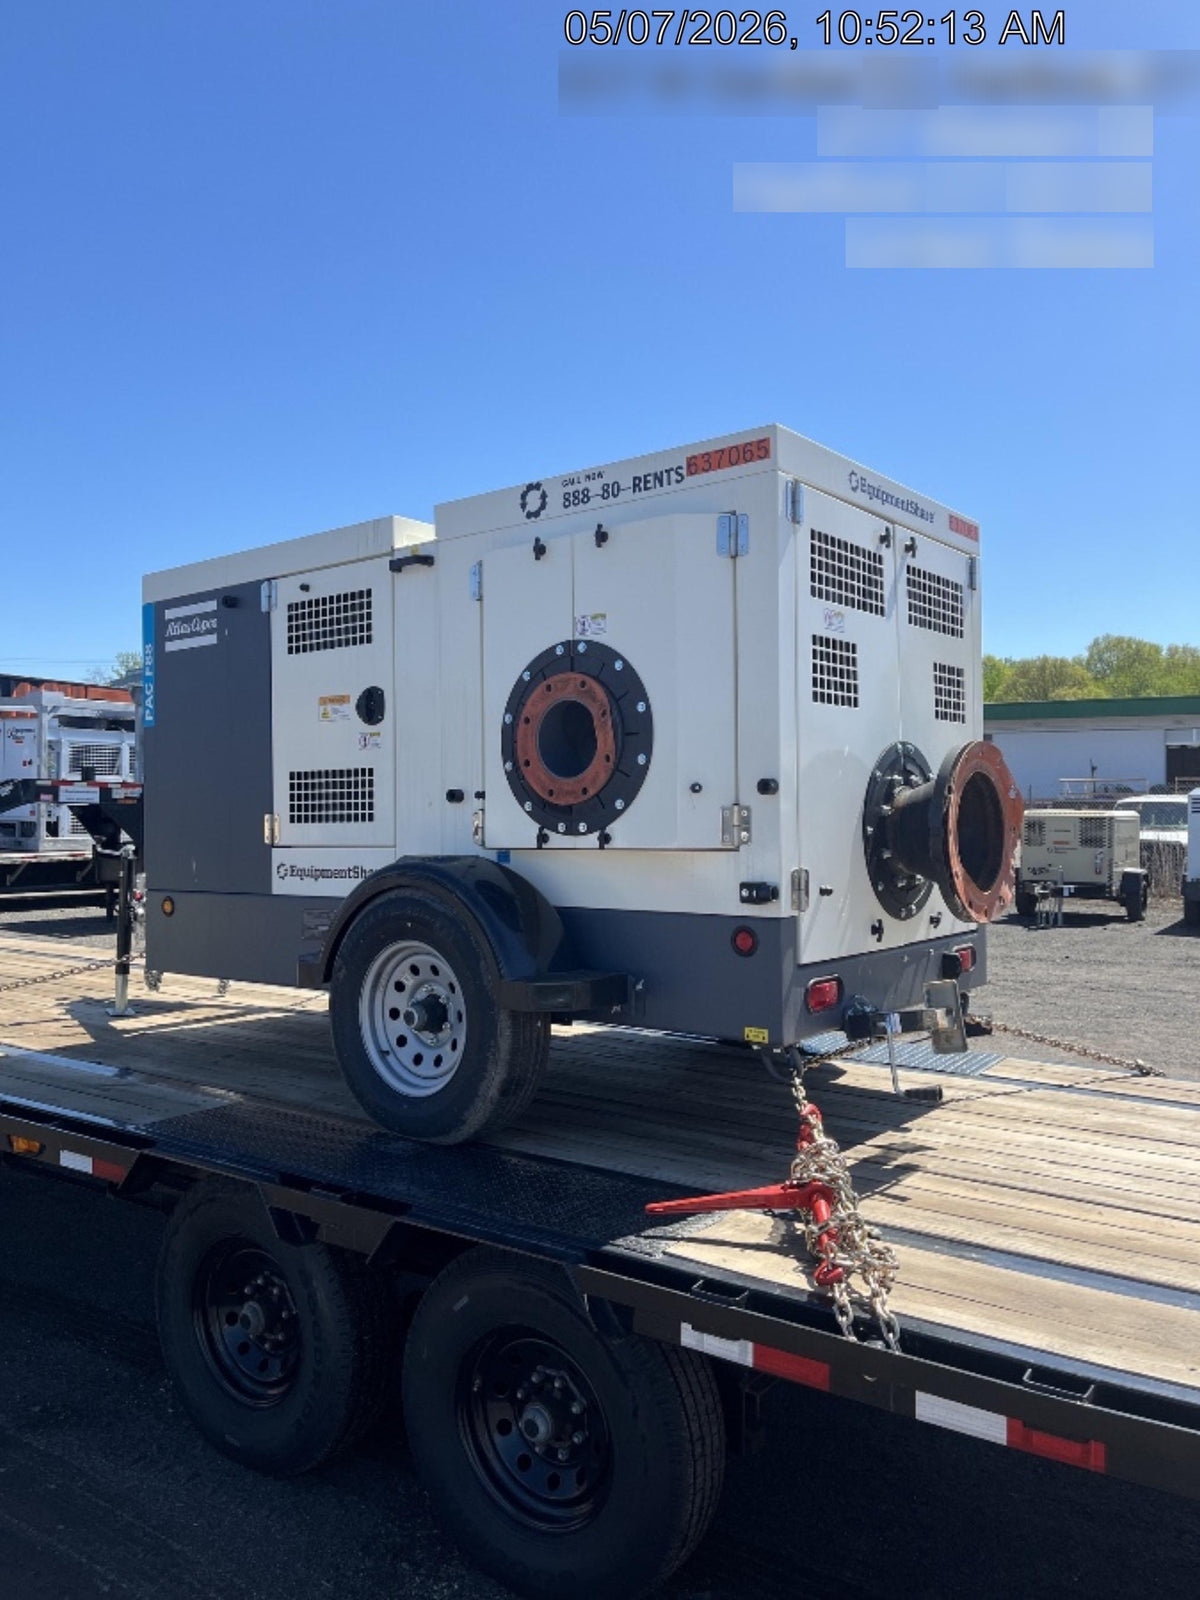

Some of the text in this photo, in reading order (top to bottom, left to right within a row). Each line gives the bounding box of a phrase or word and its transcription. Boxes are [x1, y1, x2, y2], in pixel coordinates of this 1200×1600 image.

[687, 438, 769, 476] 637065
[562, 465, 685, 509] 888-80-RENTS
[144, 682, 154, 721] PAC
[289, 864, 375, 882] EquipmentSha
